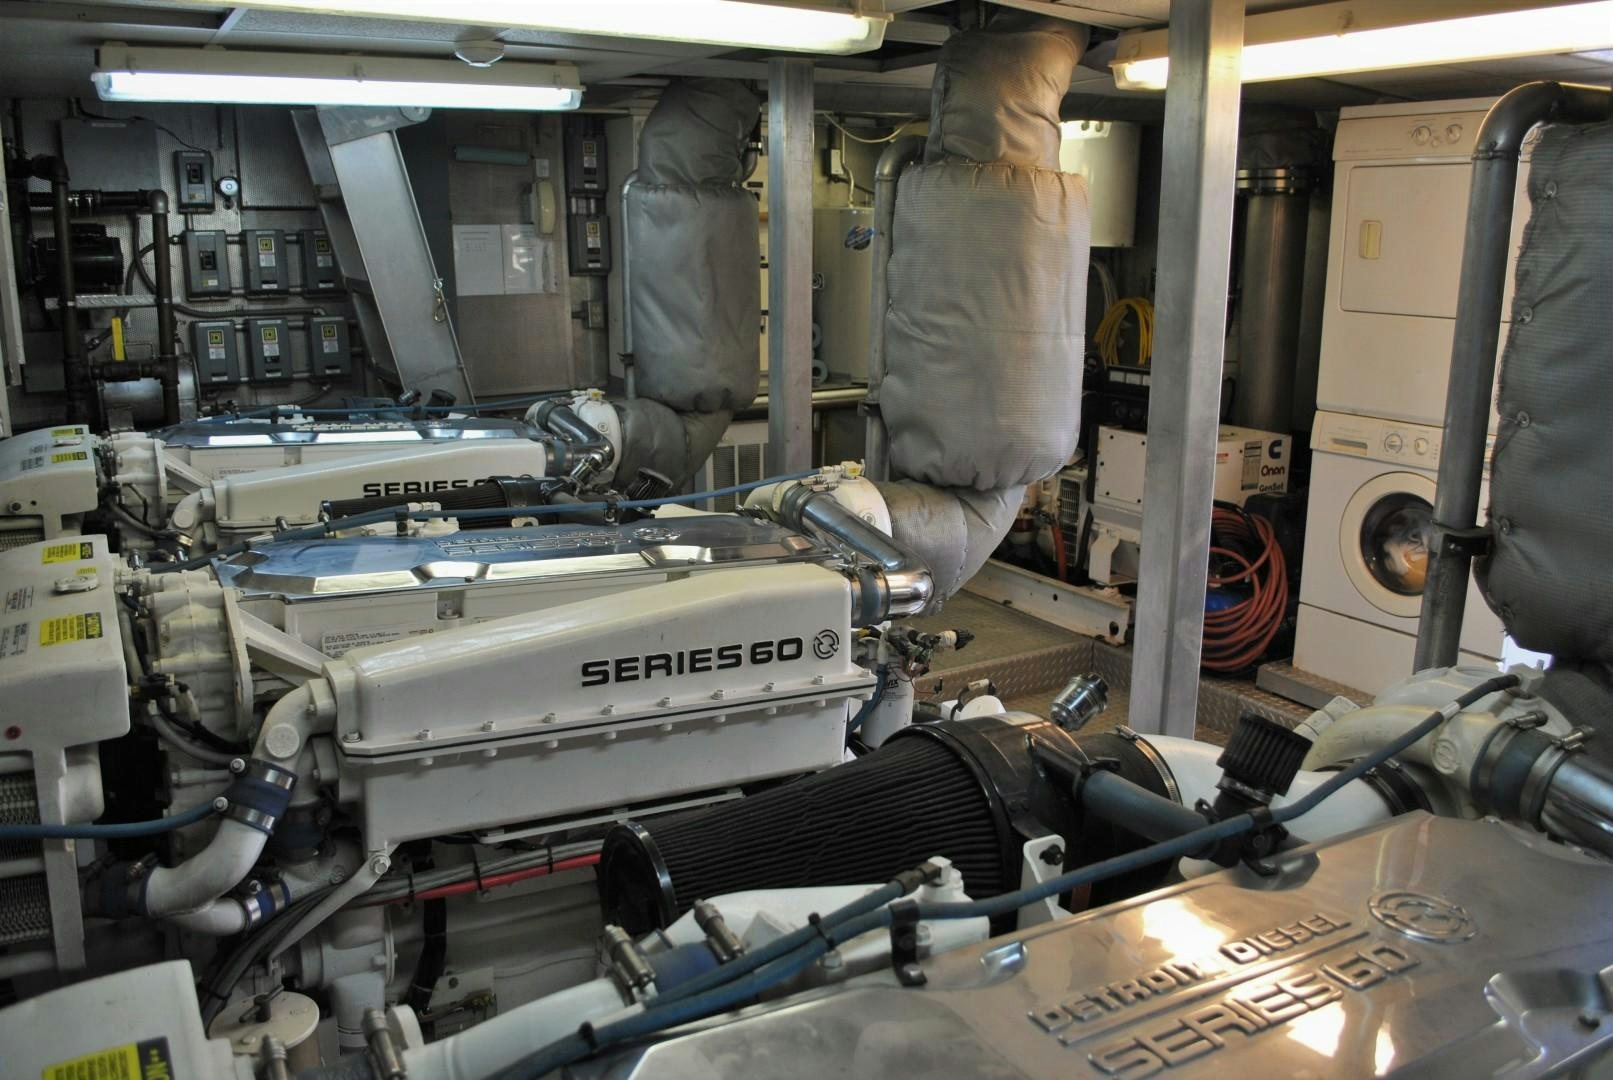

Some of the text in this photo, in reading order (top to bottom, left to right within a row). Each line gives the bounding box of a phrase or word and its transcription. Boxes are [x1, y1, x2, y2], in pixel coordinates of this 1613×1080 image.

[363, 479, 468, 498] SERIES
[581, 637, 803, 687] SERIES 60
[1027, 911, 1352, 1033] DETROIT DIESEL
[1087, 945, 1421, 1080] SERIES 60
